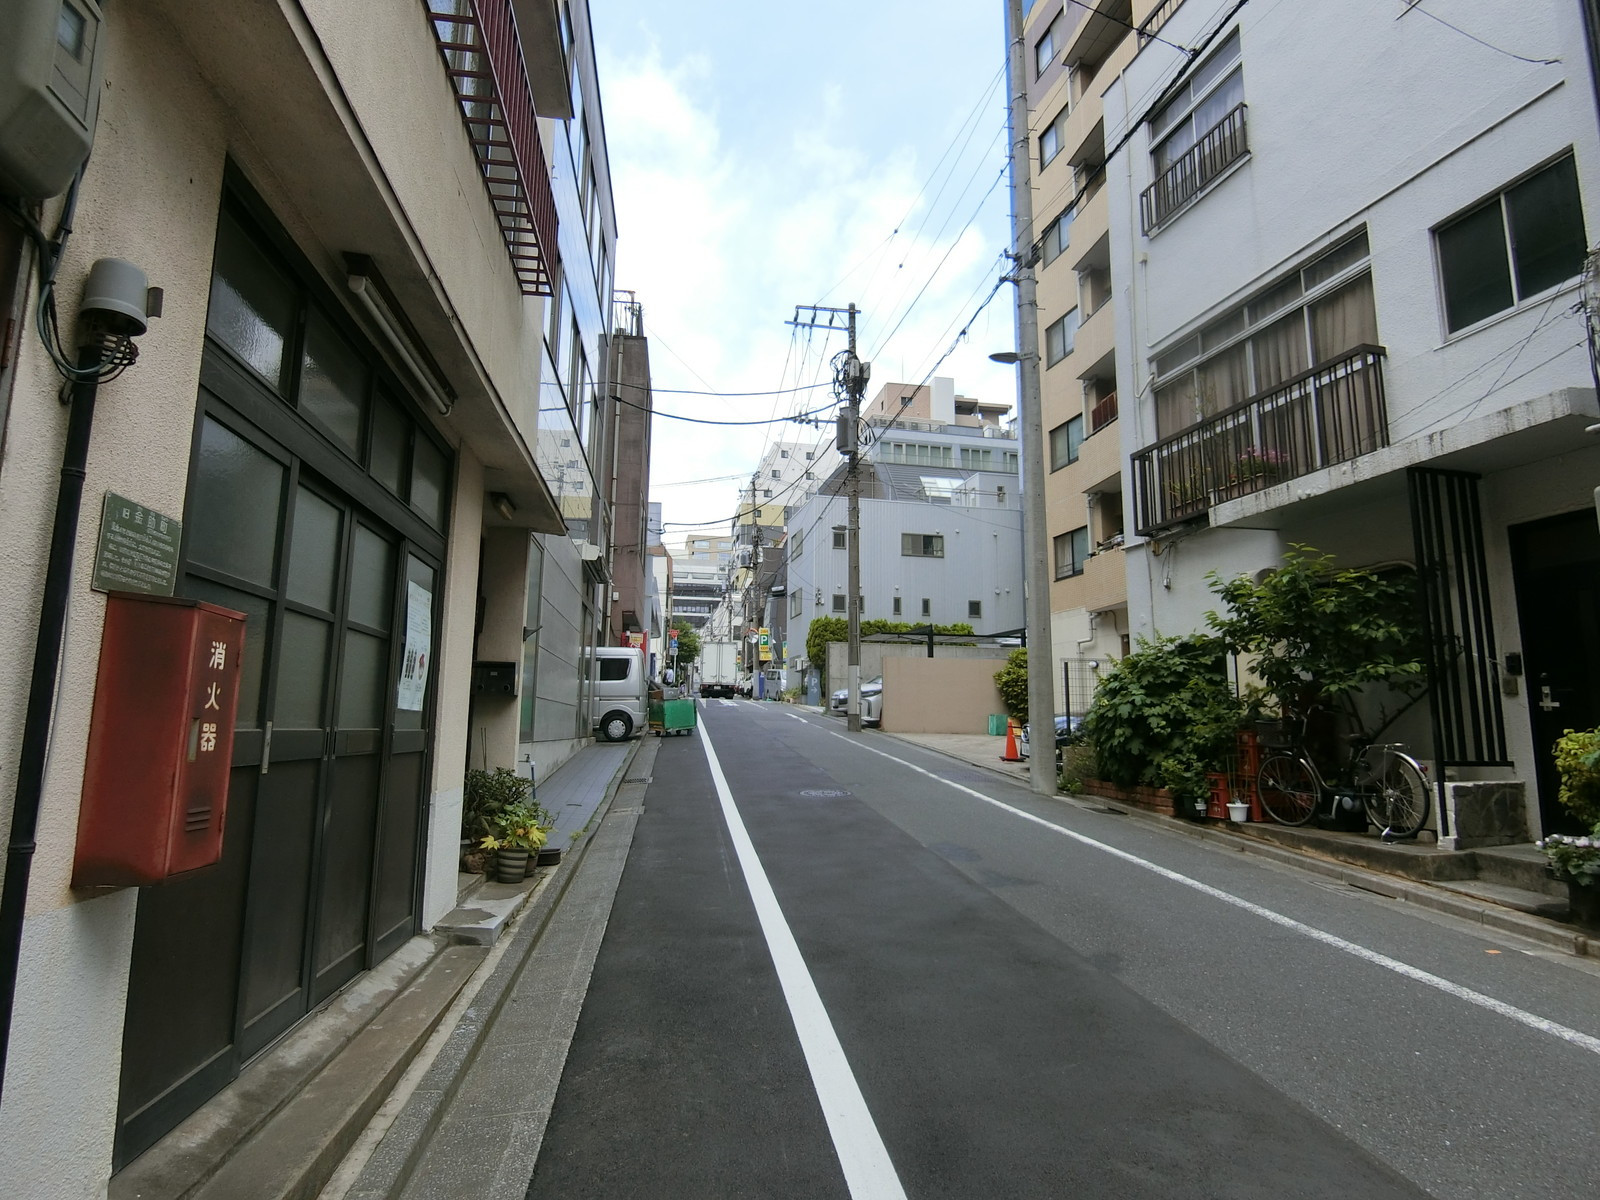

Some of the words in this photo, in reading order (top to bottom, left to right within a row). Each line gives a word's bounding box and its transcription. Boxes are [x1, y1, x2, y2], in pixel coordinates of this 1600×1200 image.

[761, 635, 768, 645] P
[811, 677, 818, 686] P
[200, 641, 227, 752] 消火器
